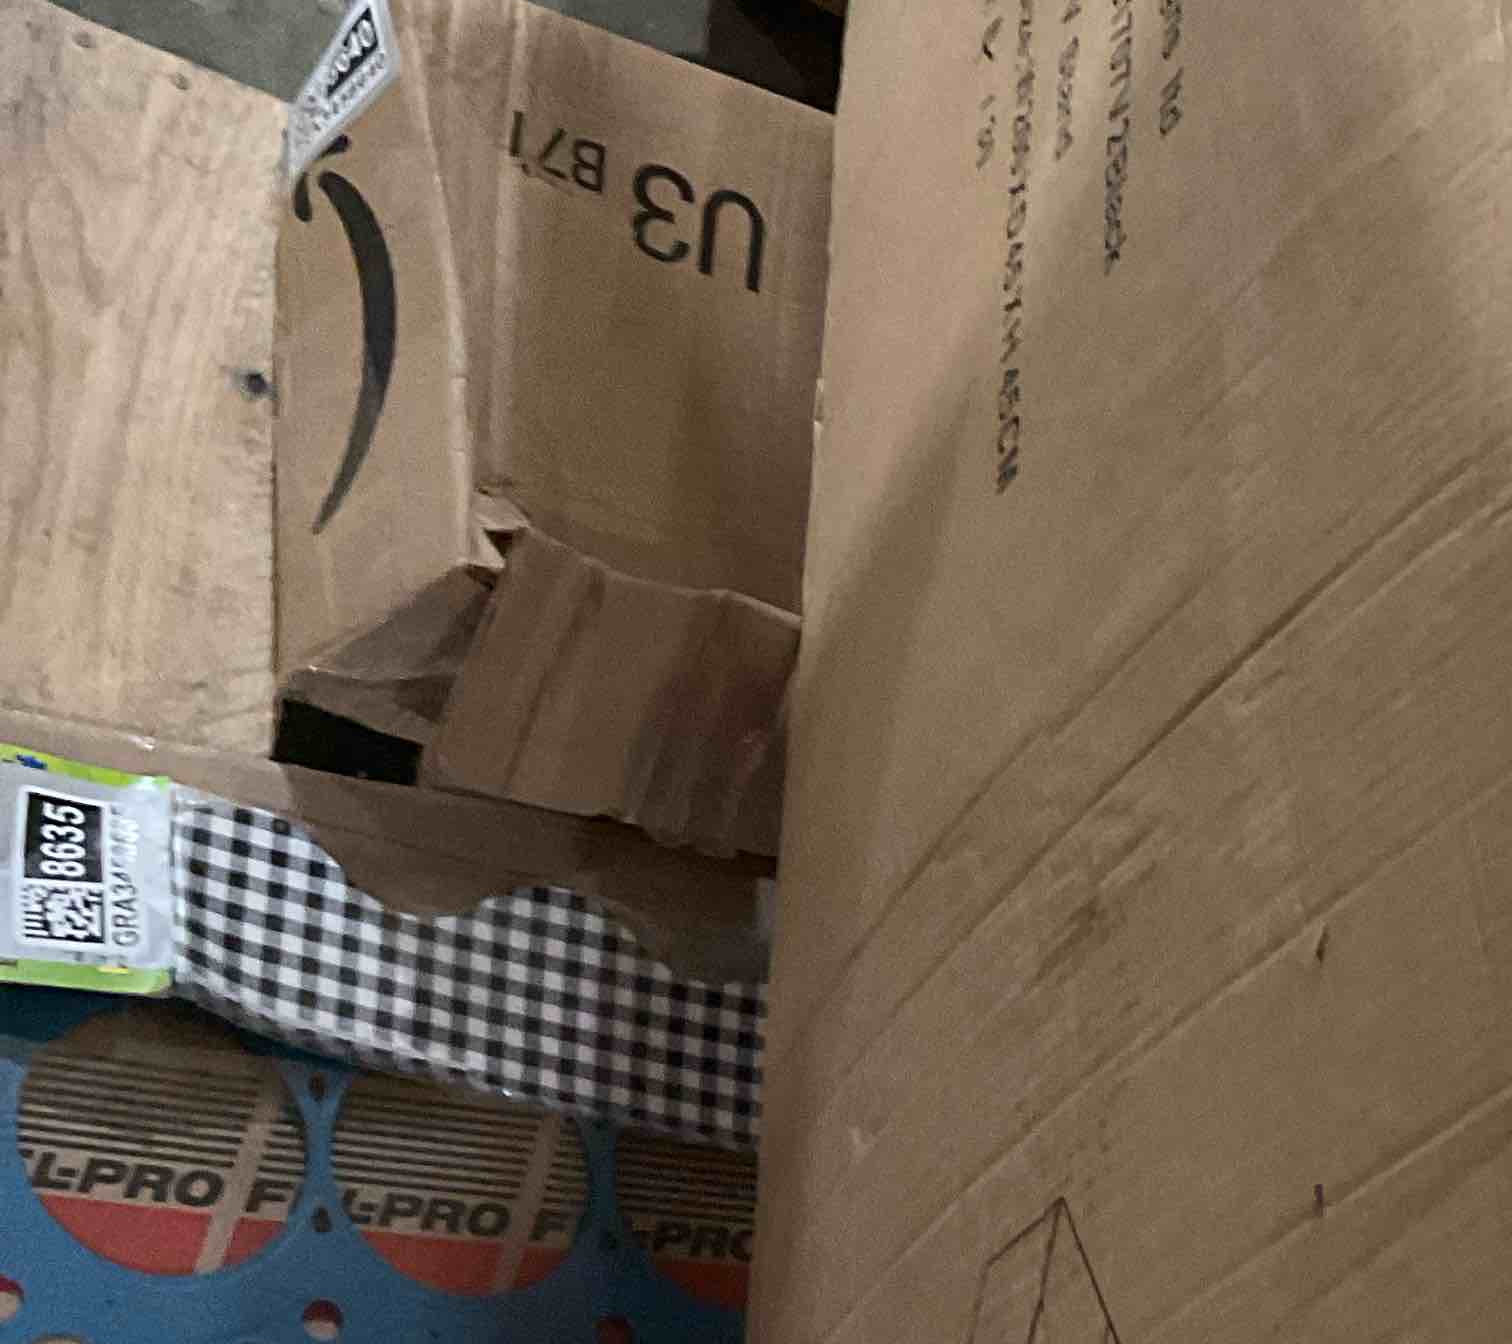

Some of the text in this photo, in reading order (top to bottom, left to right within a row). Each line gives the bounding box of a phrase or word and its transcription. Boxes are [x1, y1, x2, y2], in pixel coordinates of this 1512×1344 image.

[509, 110, 766, 293] U3 B71
[40, 801, 86, 879] 8635
